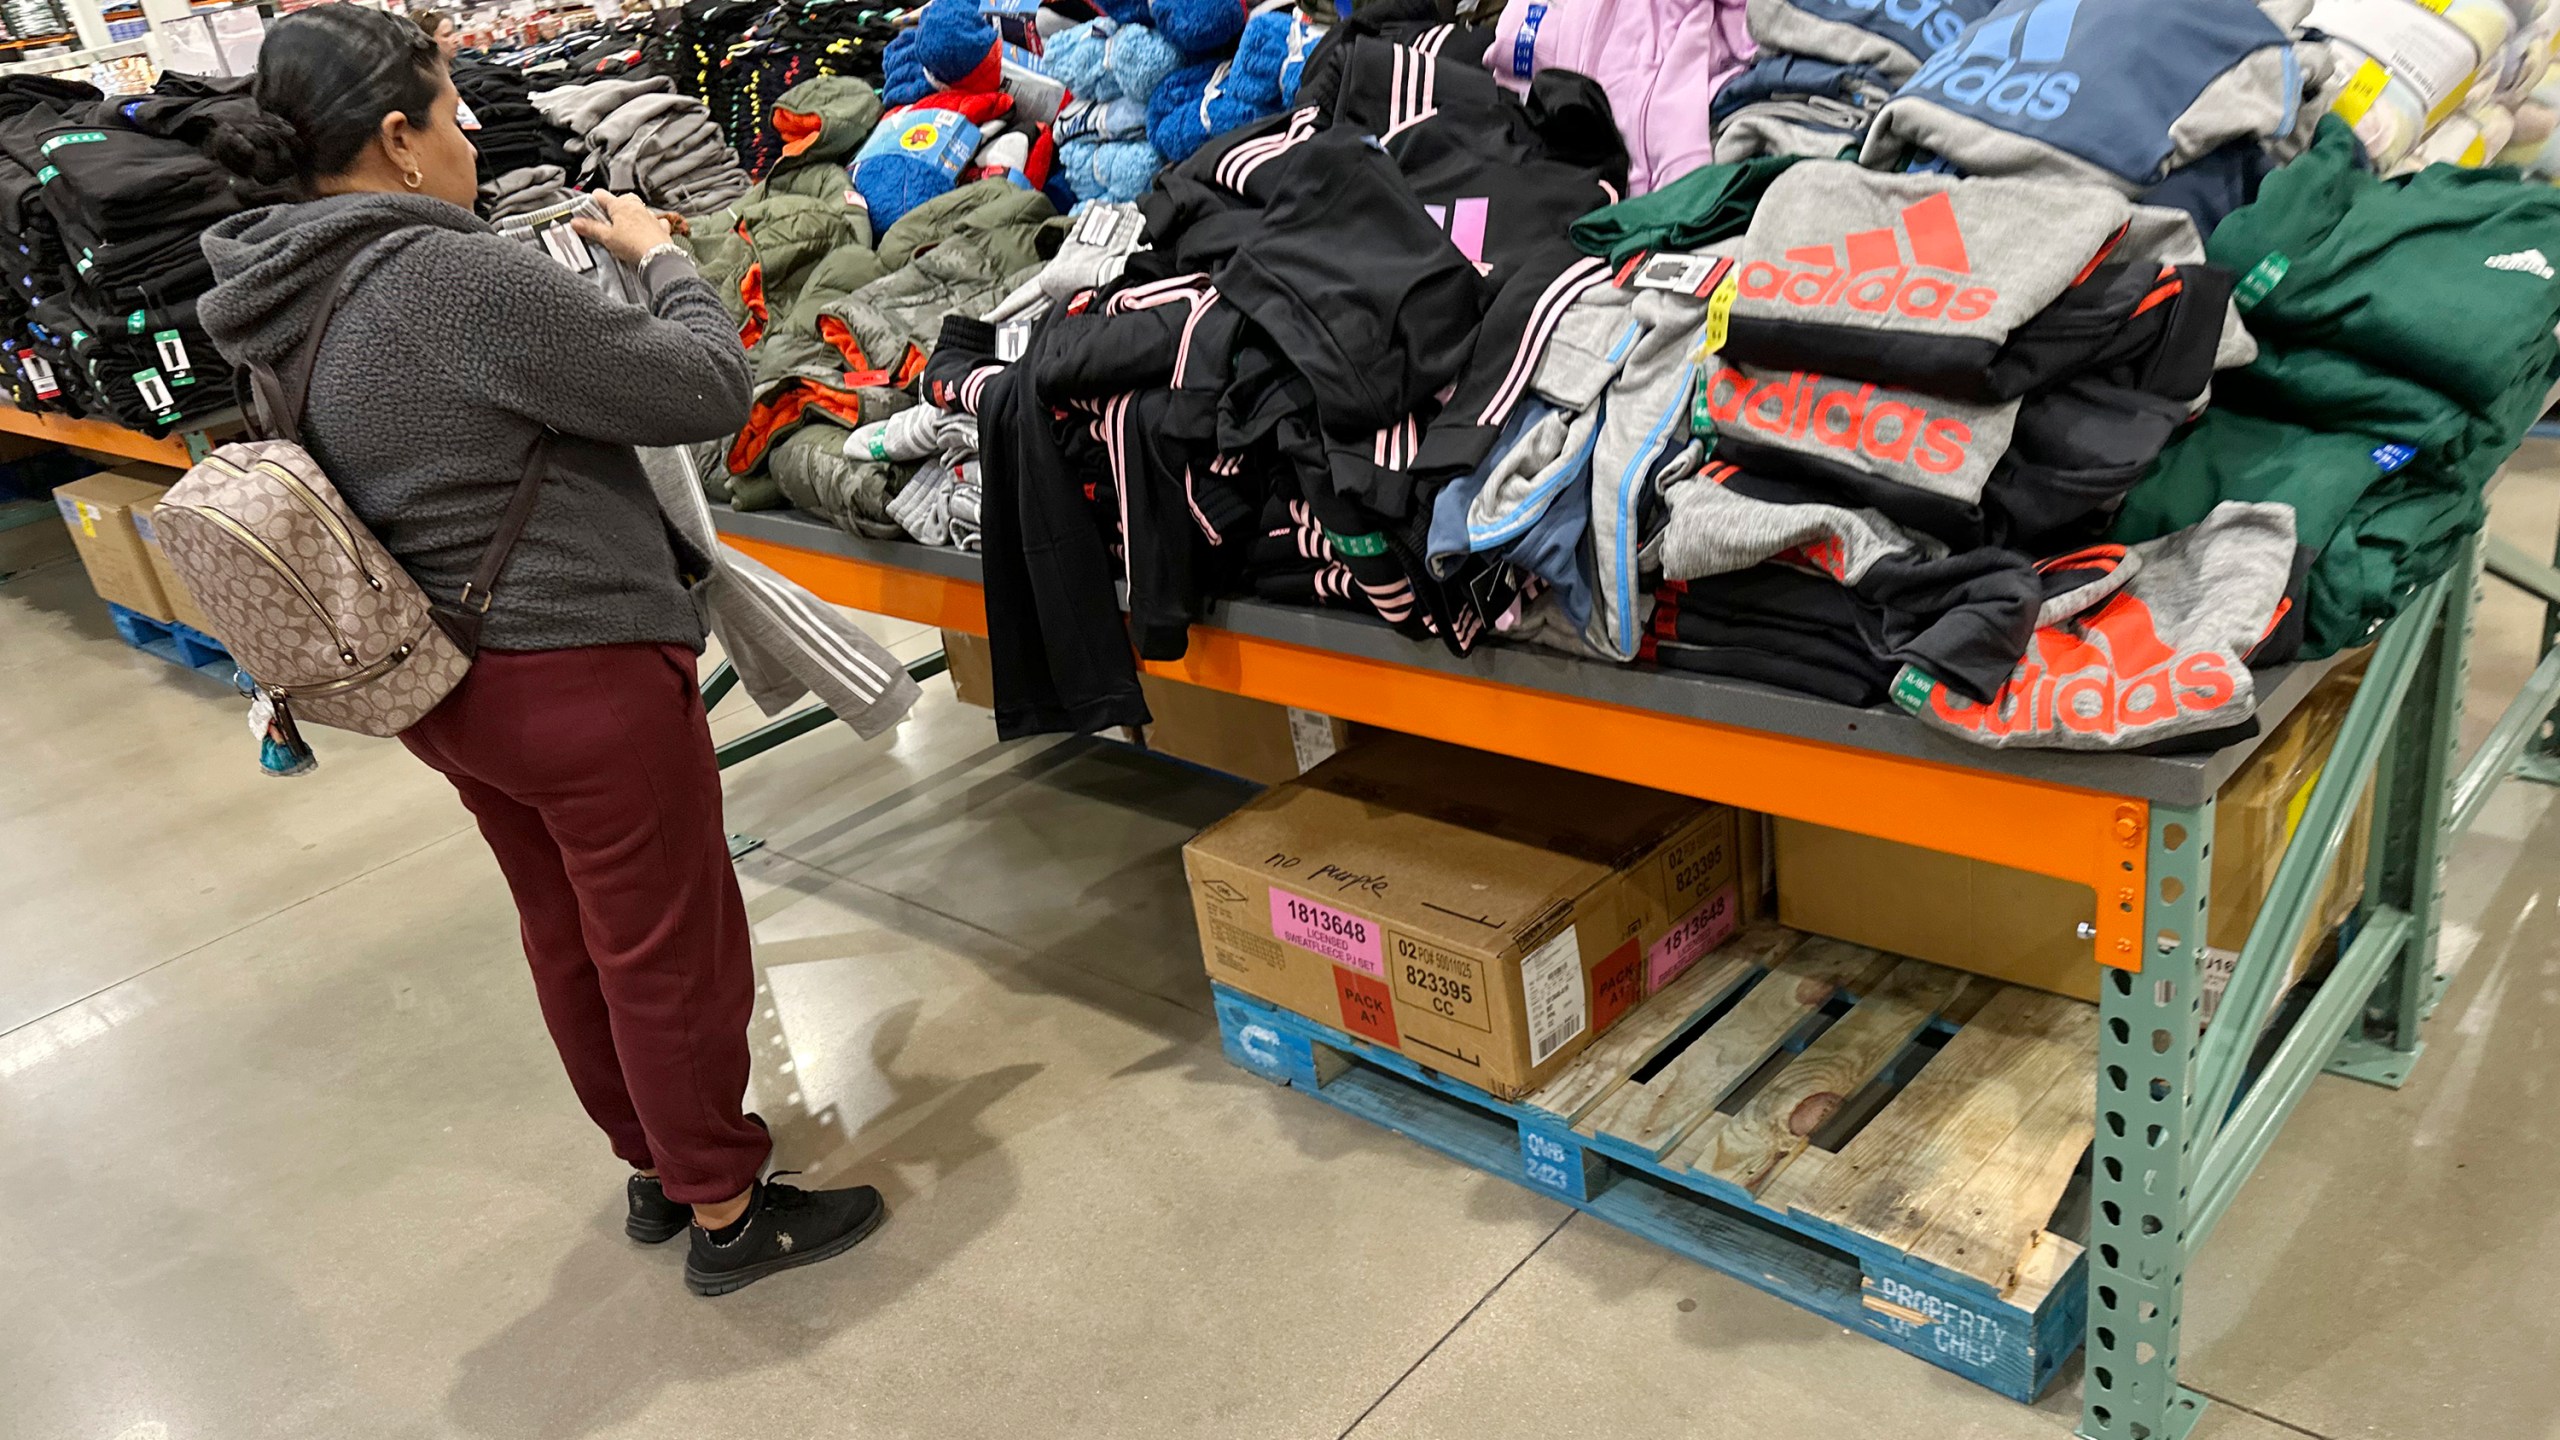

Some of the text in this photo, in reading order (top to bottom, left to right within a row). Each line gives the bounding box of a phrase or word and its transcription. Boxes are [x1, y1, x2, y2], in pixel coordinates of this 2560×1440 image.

[1738, 261, 1998, 322] adidas
[1706, 367, 1972, 475] adidas
[1264, 853, 1388, 899] no purple
[1668, 847, 1684, 870] 02
[1676, 844, 1722, 893] 823395
[1287, 899, 1367, 944] 1813648
[1306, 927, 1349, 951] LICENSED
[1664, 896, 1726, 956] 1813648
[1284, 930, 1375, 972] SWEATFLEECE PJ SET
[1398, 939, 1418, 960] 02
[1344, 987, 1386, 1014] PACK
[1406, 965, 1473, 1004] 823395
[1600, 961, 1635, 998] PACK
[1360, 1010, 1378, 1026] A1
[1432, 996, 1456, 1017] CC
[1881, 1277, 2007, 1348] PROPERTY
[1933, 1325, 1997, 1368] CHEP
